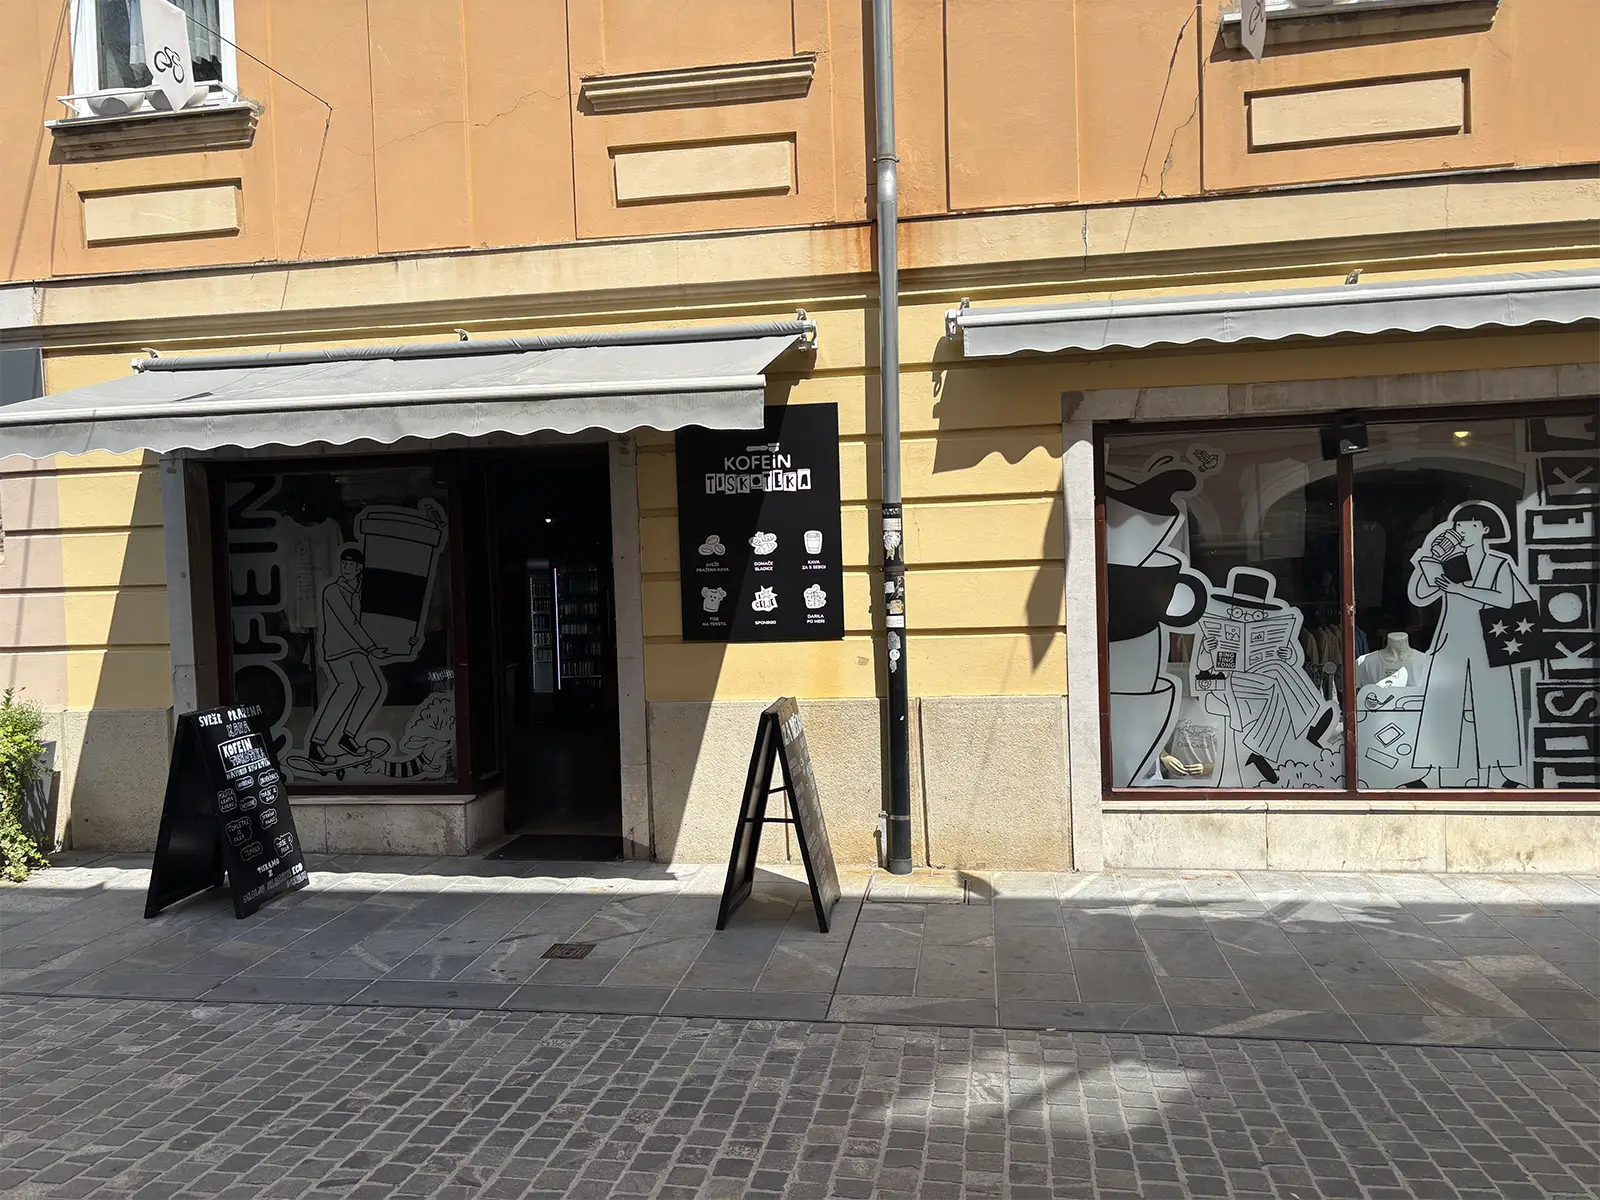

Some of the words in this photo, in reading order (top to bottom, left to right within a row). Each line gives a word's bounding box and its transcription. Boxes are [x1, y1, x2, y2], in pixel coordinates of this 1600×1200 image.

[705, 469, 811, 495] TISKOTEKA
[198, 713, 223, 727] SVEŽE
[227, 704, 263, 722] PRAŽENA
[222, 738, 253, 758] KOFEIN
[291, 862, 304, 875] ECO
